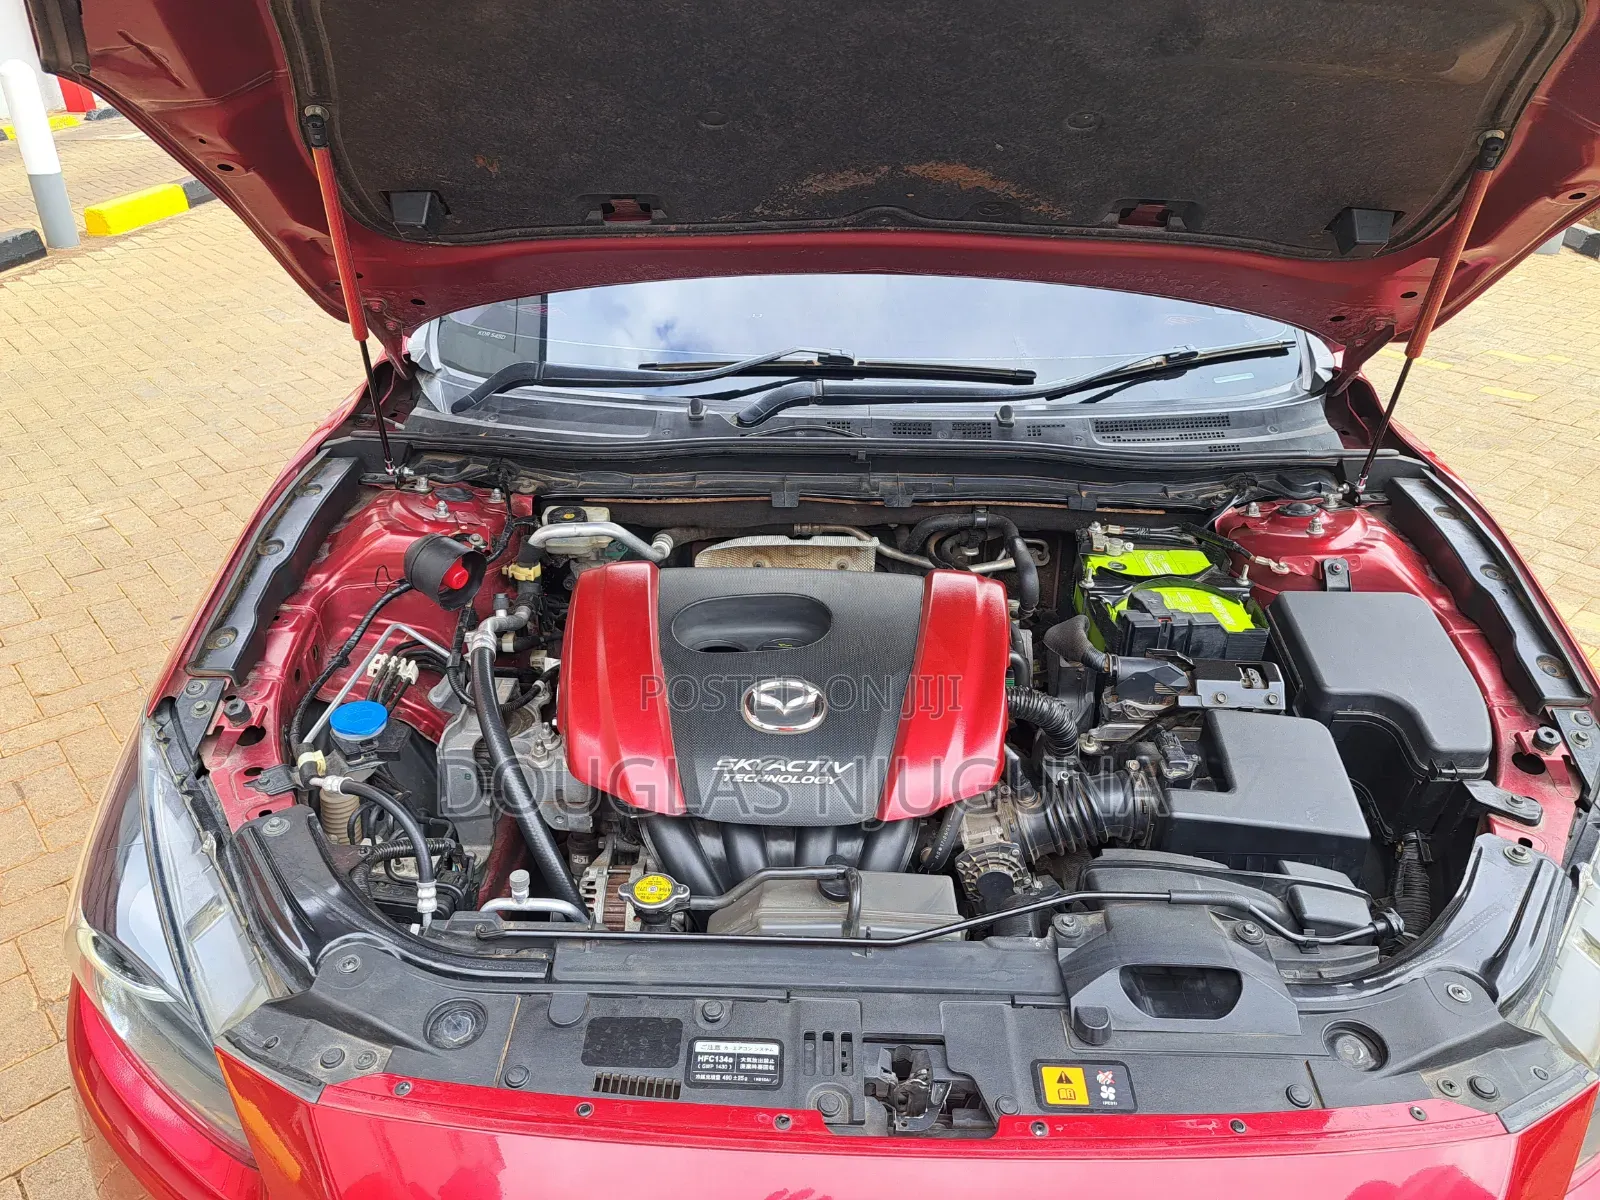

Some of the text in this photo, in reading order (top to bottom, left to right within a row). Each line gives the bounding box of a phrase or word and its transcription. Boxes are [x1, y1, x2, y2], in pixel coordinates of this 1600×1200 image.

[712, 758, 854, 773] SKYACTIV
[722, 773, 841, 785] TECHNOLOGY
[697, 1055, 733, 1063] HFC134a
